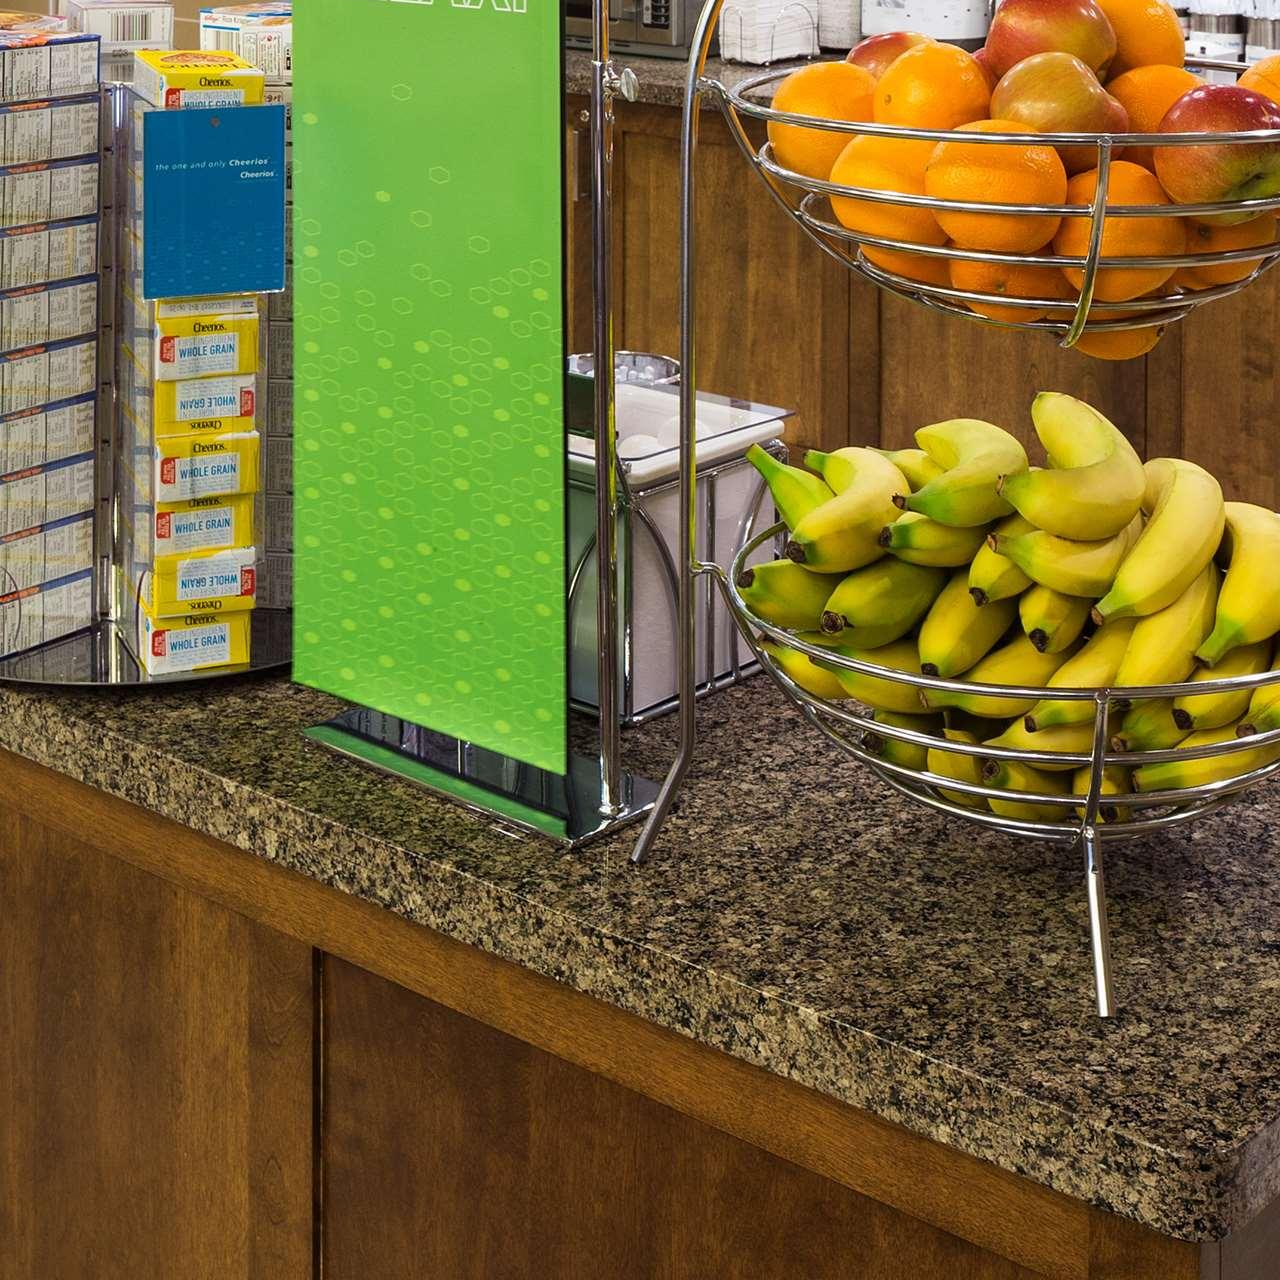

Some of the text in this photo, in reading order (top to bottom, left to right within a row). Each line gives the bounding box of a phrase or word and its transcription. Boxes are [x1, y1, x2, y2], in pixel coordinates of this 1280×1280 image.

[155, 163, 169, 171] the
[190, 161, 206, 169] and
[208, 159, 226, 169] only
[229, 158, 269, 167] Cheerios
[240, 170, 275, 179] Cheerios
[179, 346, 208, 358] WHOLE
[210, 344, 235, 355] GRAIN
[180, 464, 236, 479] WHOLE GRAIN
[175, 518, 231, 534] WHOLE GRAIN
[181, 574, 238, 589] WHOLE GRAIN
[170, 634, 226, 652] WHOLE GRAIN
